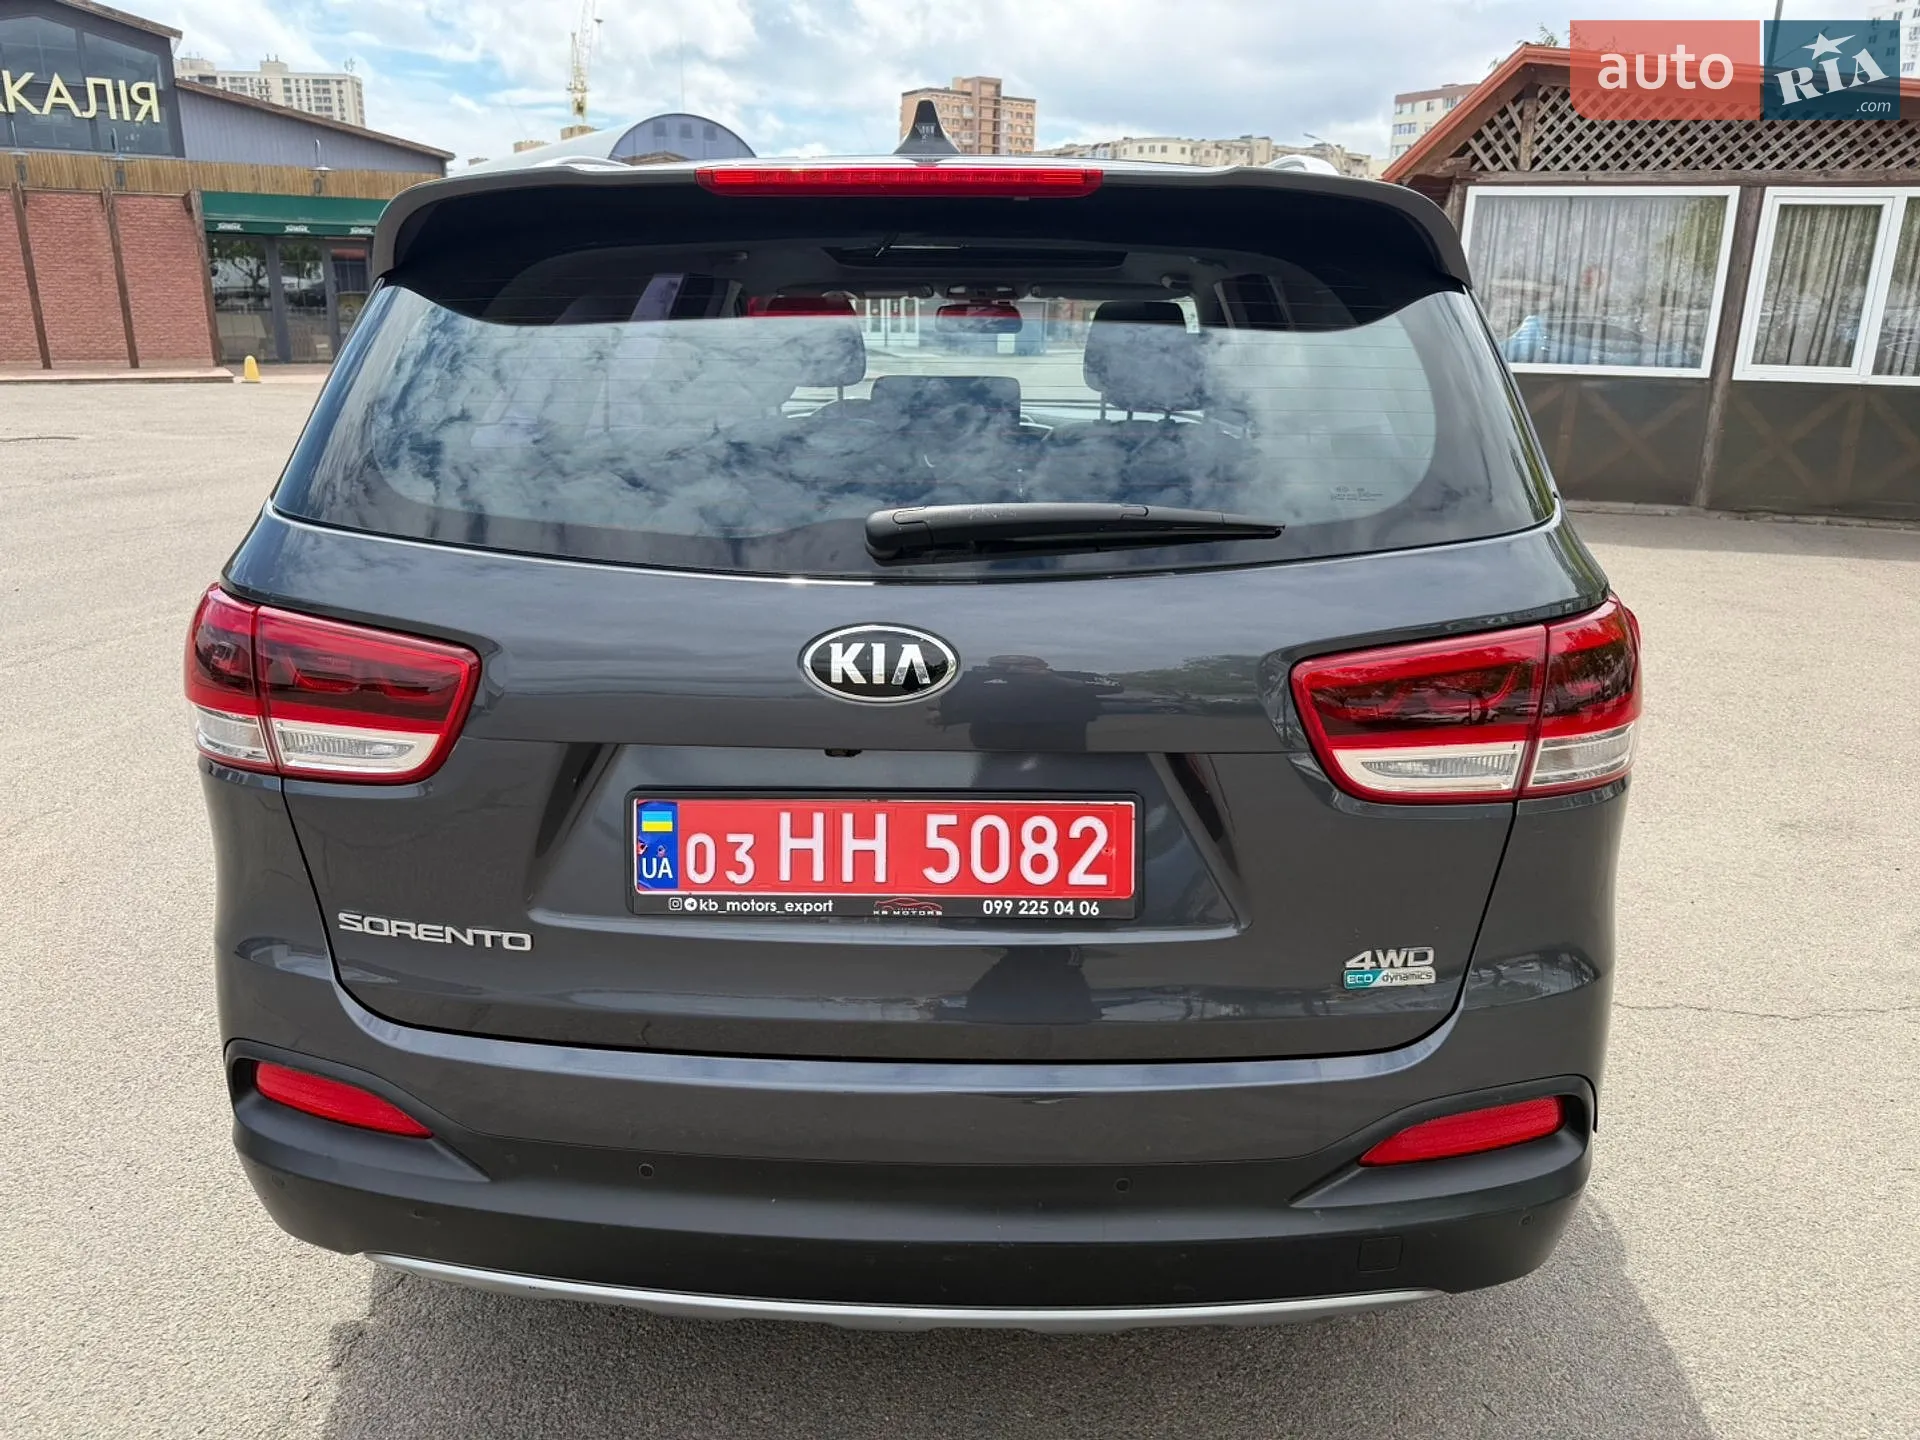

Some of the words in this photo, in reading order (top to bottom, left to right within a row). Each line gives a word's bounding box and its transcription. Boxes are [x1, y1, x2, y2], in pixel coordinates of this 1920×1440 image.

[0, 70, 161, 123] КАЛІЯ
[829, 642, 931, 685] KIA
[685, 832, 755, 885] 03
[778, 811, 887, 883] HH
[922, 813, 1109, 886] 5082
[641, 857, 673, 879] UA
[699, 897, 834, 915] kb_motors_export
[982, 899, 1013, 915] 099
[1018, 900, 1049, 915] 225
[1054, 900, 1075, 916] 04
[1079, 900, 1100, 916] 06
[338, 911, 533, 951] SORENTO
[1345, 946, 1435, 970] 4WD
[1346, 973, 1374, 985] ECO
[1382, 970, 1433, 984] dynamics
